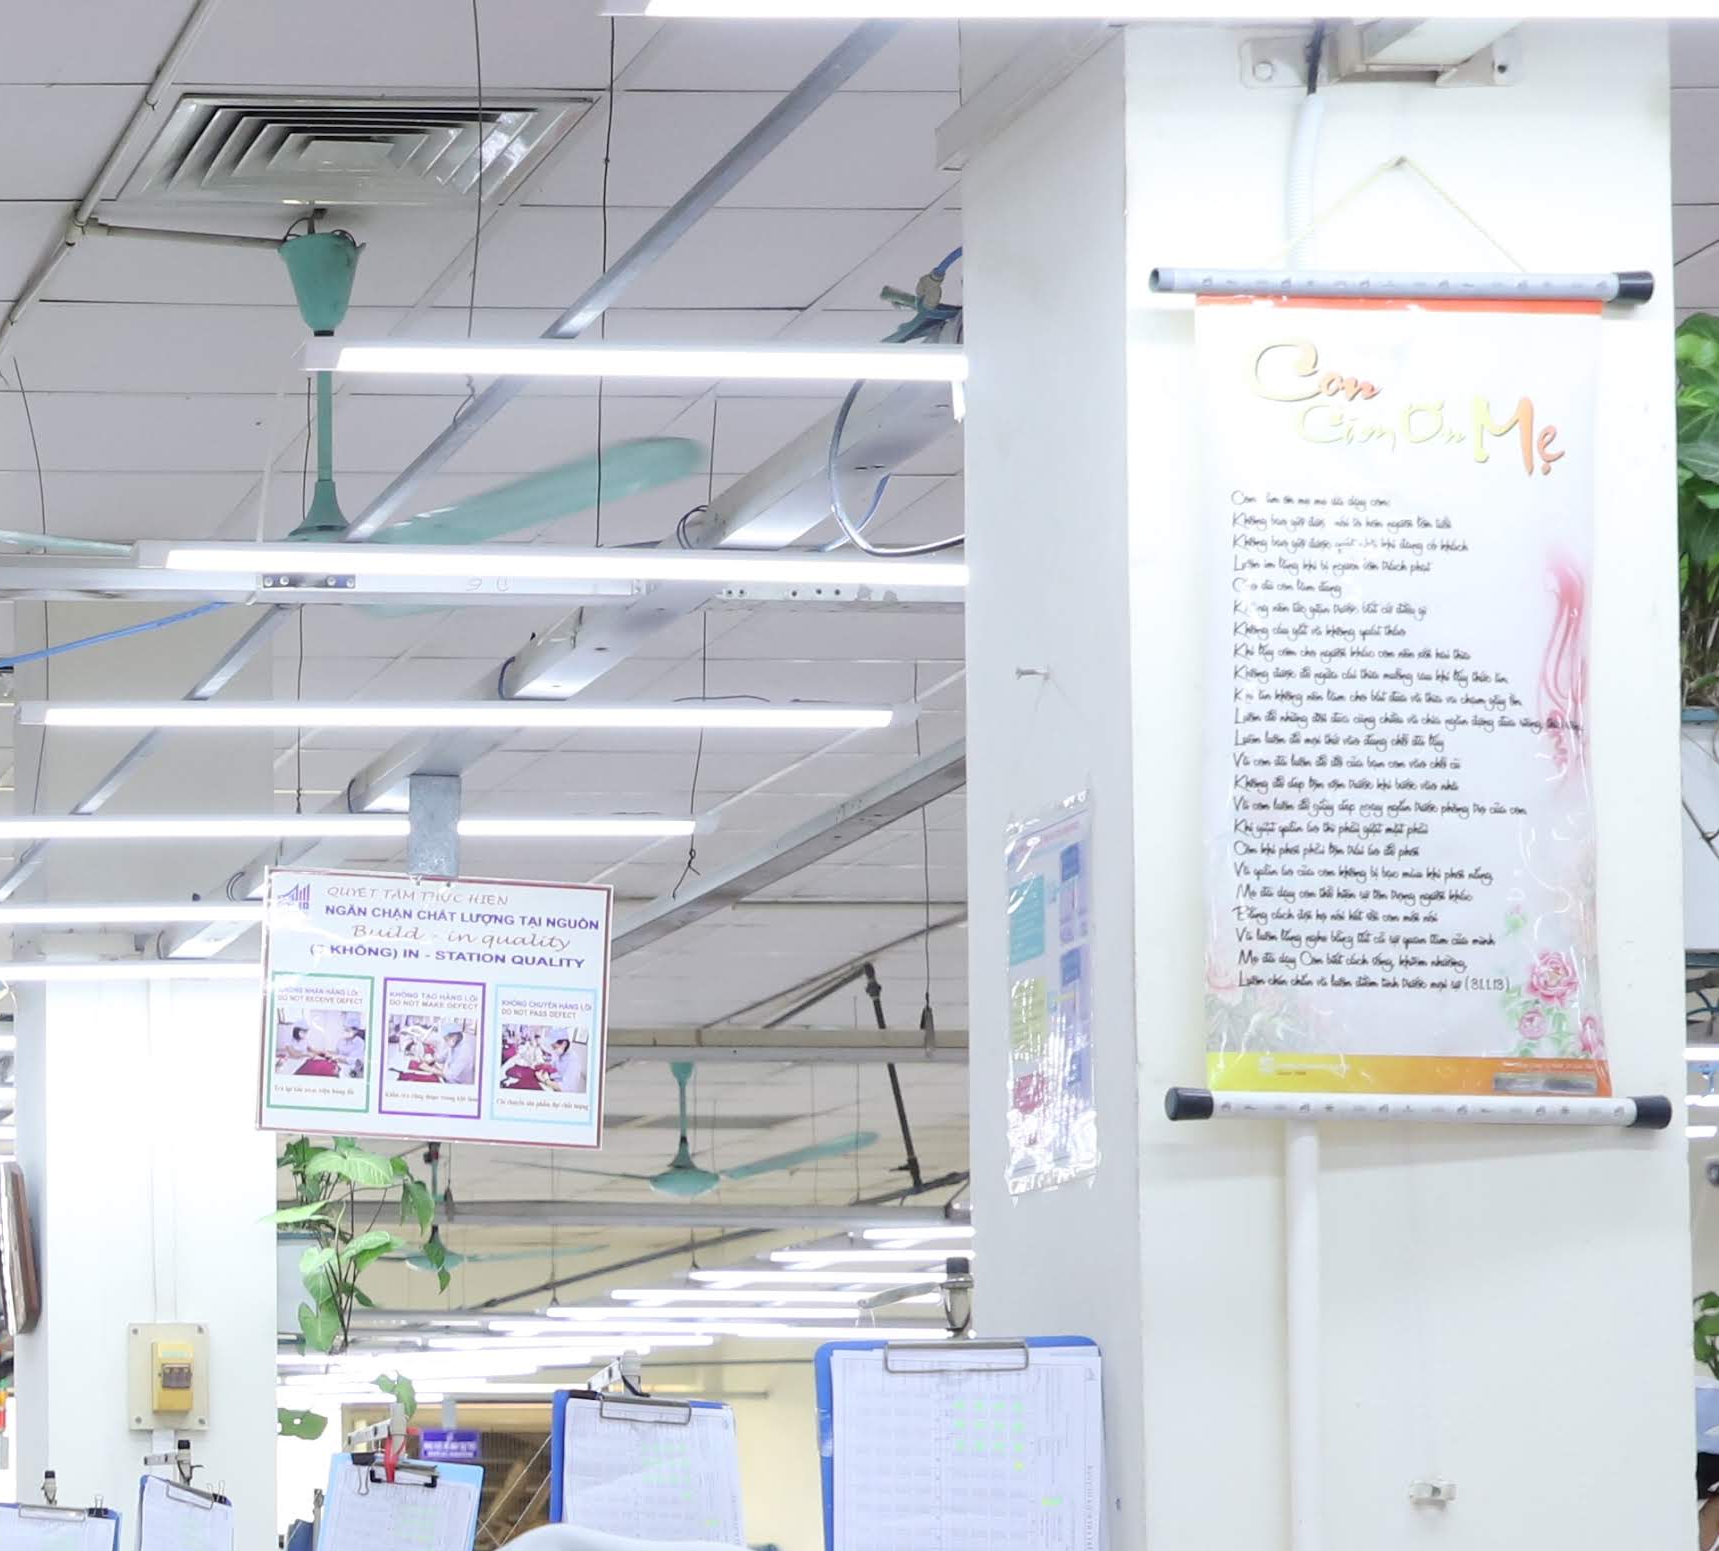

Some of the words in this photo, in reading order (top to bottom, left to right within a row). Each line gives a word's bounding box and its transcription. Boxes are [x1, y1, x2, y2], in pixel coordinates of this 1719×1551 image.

[1251, 339, 1382, 402] Con
[1473, 393, 1566, 476] Mẹ
[325, 904, 367, 918] NGĂN
[371, 906, 413, 922] CHẶN
[460, 911, 515, 926] LƯỢNG
[519, 915, 542, 929] TẠI
[353, 924, 426, 941] Build
[482, 932, 571, 953] quality
[403, 949, 420, 959] IN
[435, 950, 506, 964] STATION
[512, 954, 586, 969] QUALITY
[389, 999, 402, 1007] DO
[450, 1002, 478, 1010] DEFECT
[513, 1009, 528, 1017] NOT
[549, 1011, 577, 1019] DEFECT
